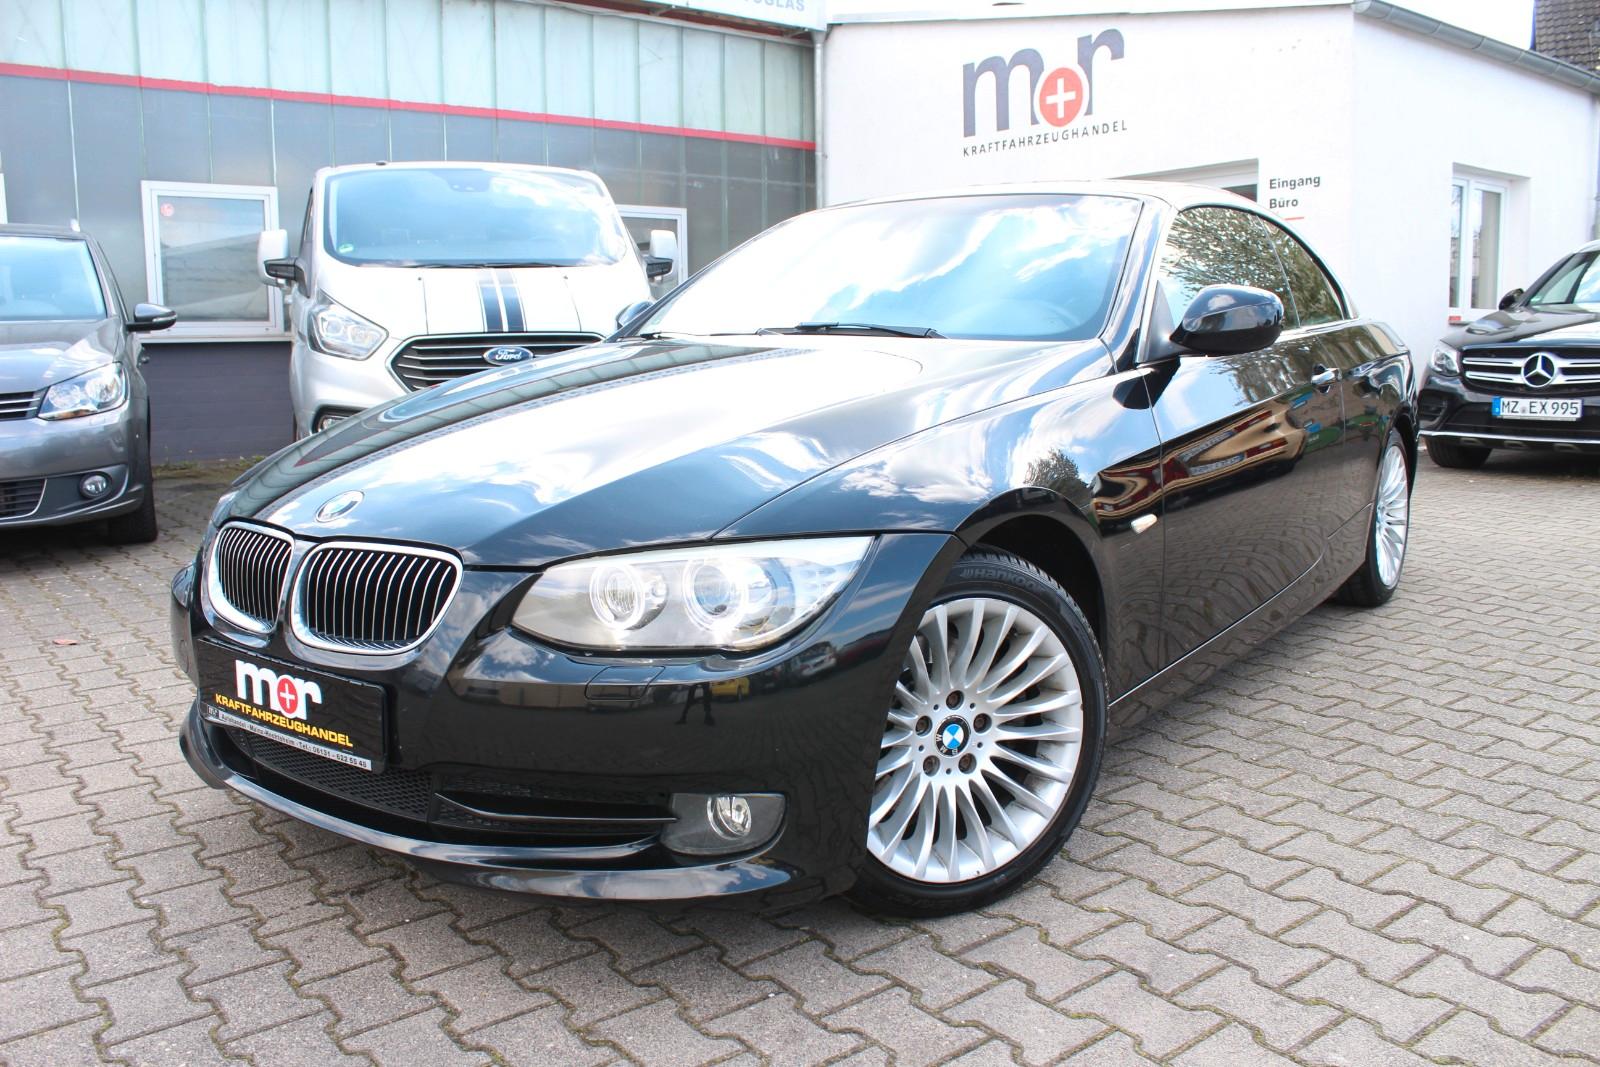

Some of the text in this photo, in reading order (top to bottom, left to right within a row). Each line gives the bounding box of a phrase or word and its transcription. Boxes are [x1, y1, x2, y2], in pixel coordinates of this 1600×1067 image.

[963, 119, 1128, 157] KRAFTFAHRZEUGHANDEL
[1269, 176, 1321, 190] Eingang
[1269, 197, 1299, 209] Büro
[495, 349, 523, 361] Ford
[1501, 400, 1579, 415] MZ EX 995
[215, 692, 353, 748] KRAFTFAHRZEUGHANDEL
